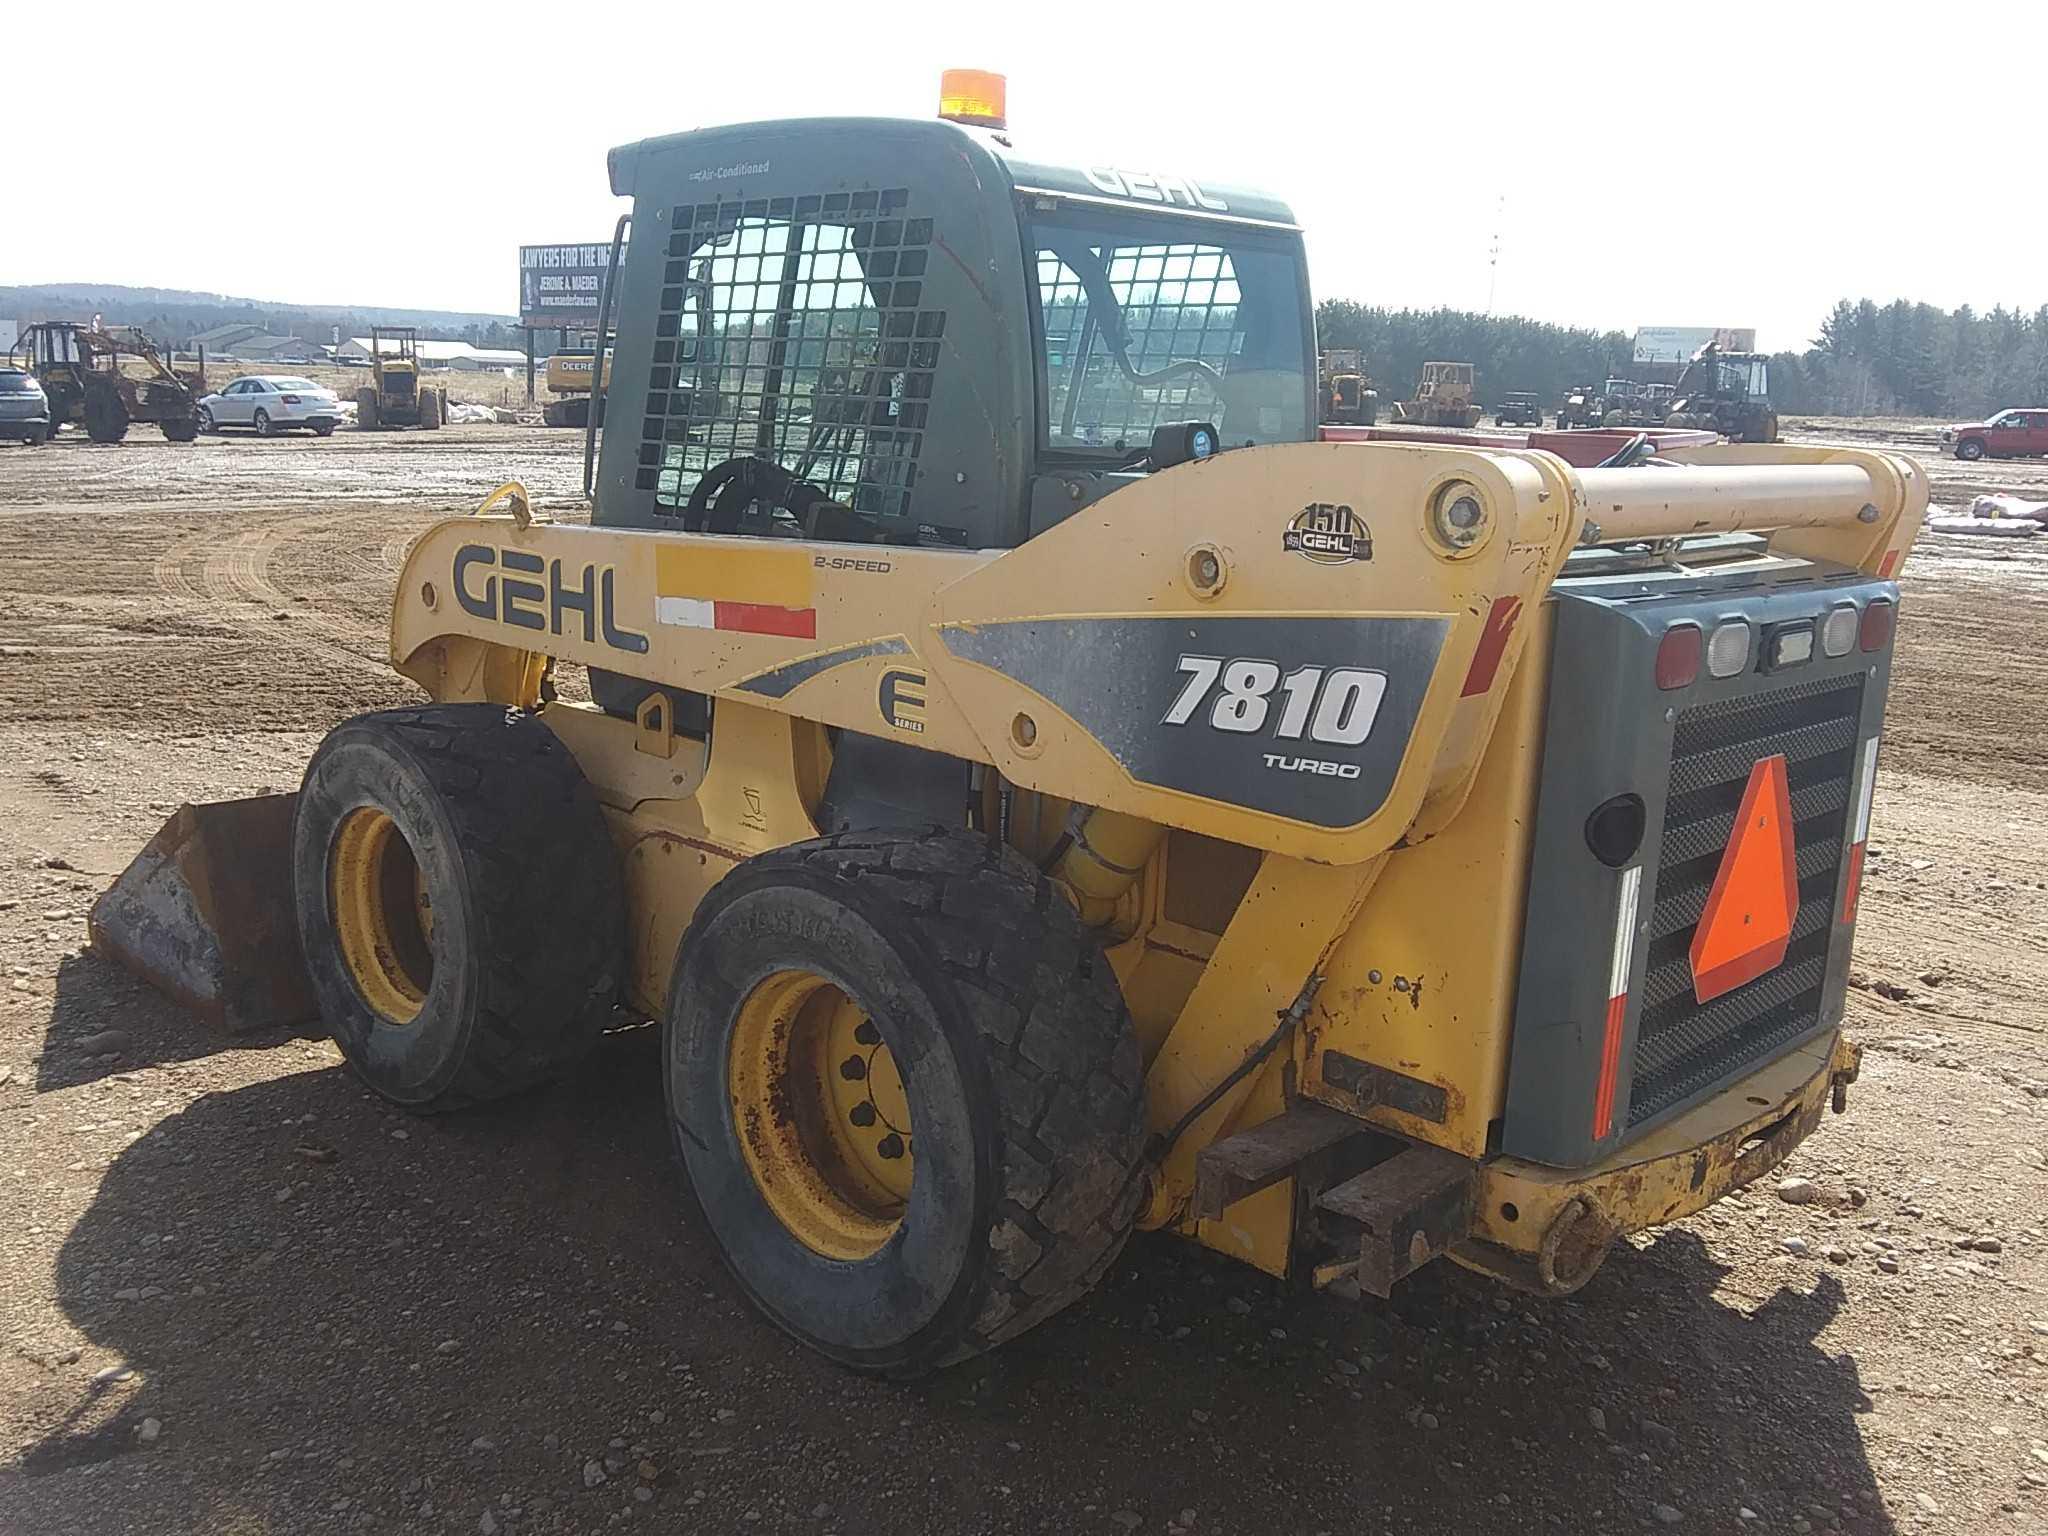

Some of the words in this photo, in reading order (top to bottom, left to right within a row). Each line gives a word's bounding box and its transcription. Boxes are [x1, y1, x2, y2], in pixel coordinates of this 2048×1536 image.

[701, 160, 769, 181] Air-Conditioned
[1082, 167, 1230, 211] GEHL
[520, 247, 560, 268] LAWYERS
[561, 246, 578, 267] FOR
[579, 245, 595, 267] THE
[540, 276, 564, 291] JEROME
[572, 276, 598, 291] MAEDER
[562, 361, 594, 371] DEERE
[1305, 502, 1353, 533] 150
[1302, 533, 1350, 551] GEHL
[814, 556, 891, 574] 2-SPEED
[453, 544, 648, 654] GEHL
[879, 670, 926, 733] E
[1162, 654, 1388, 745] 7810
[894, 718, 923, 732] SERIES
[1262, 753, 1361, 780] TURBO
